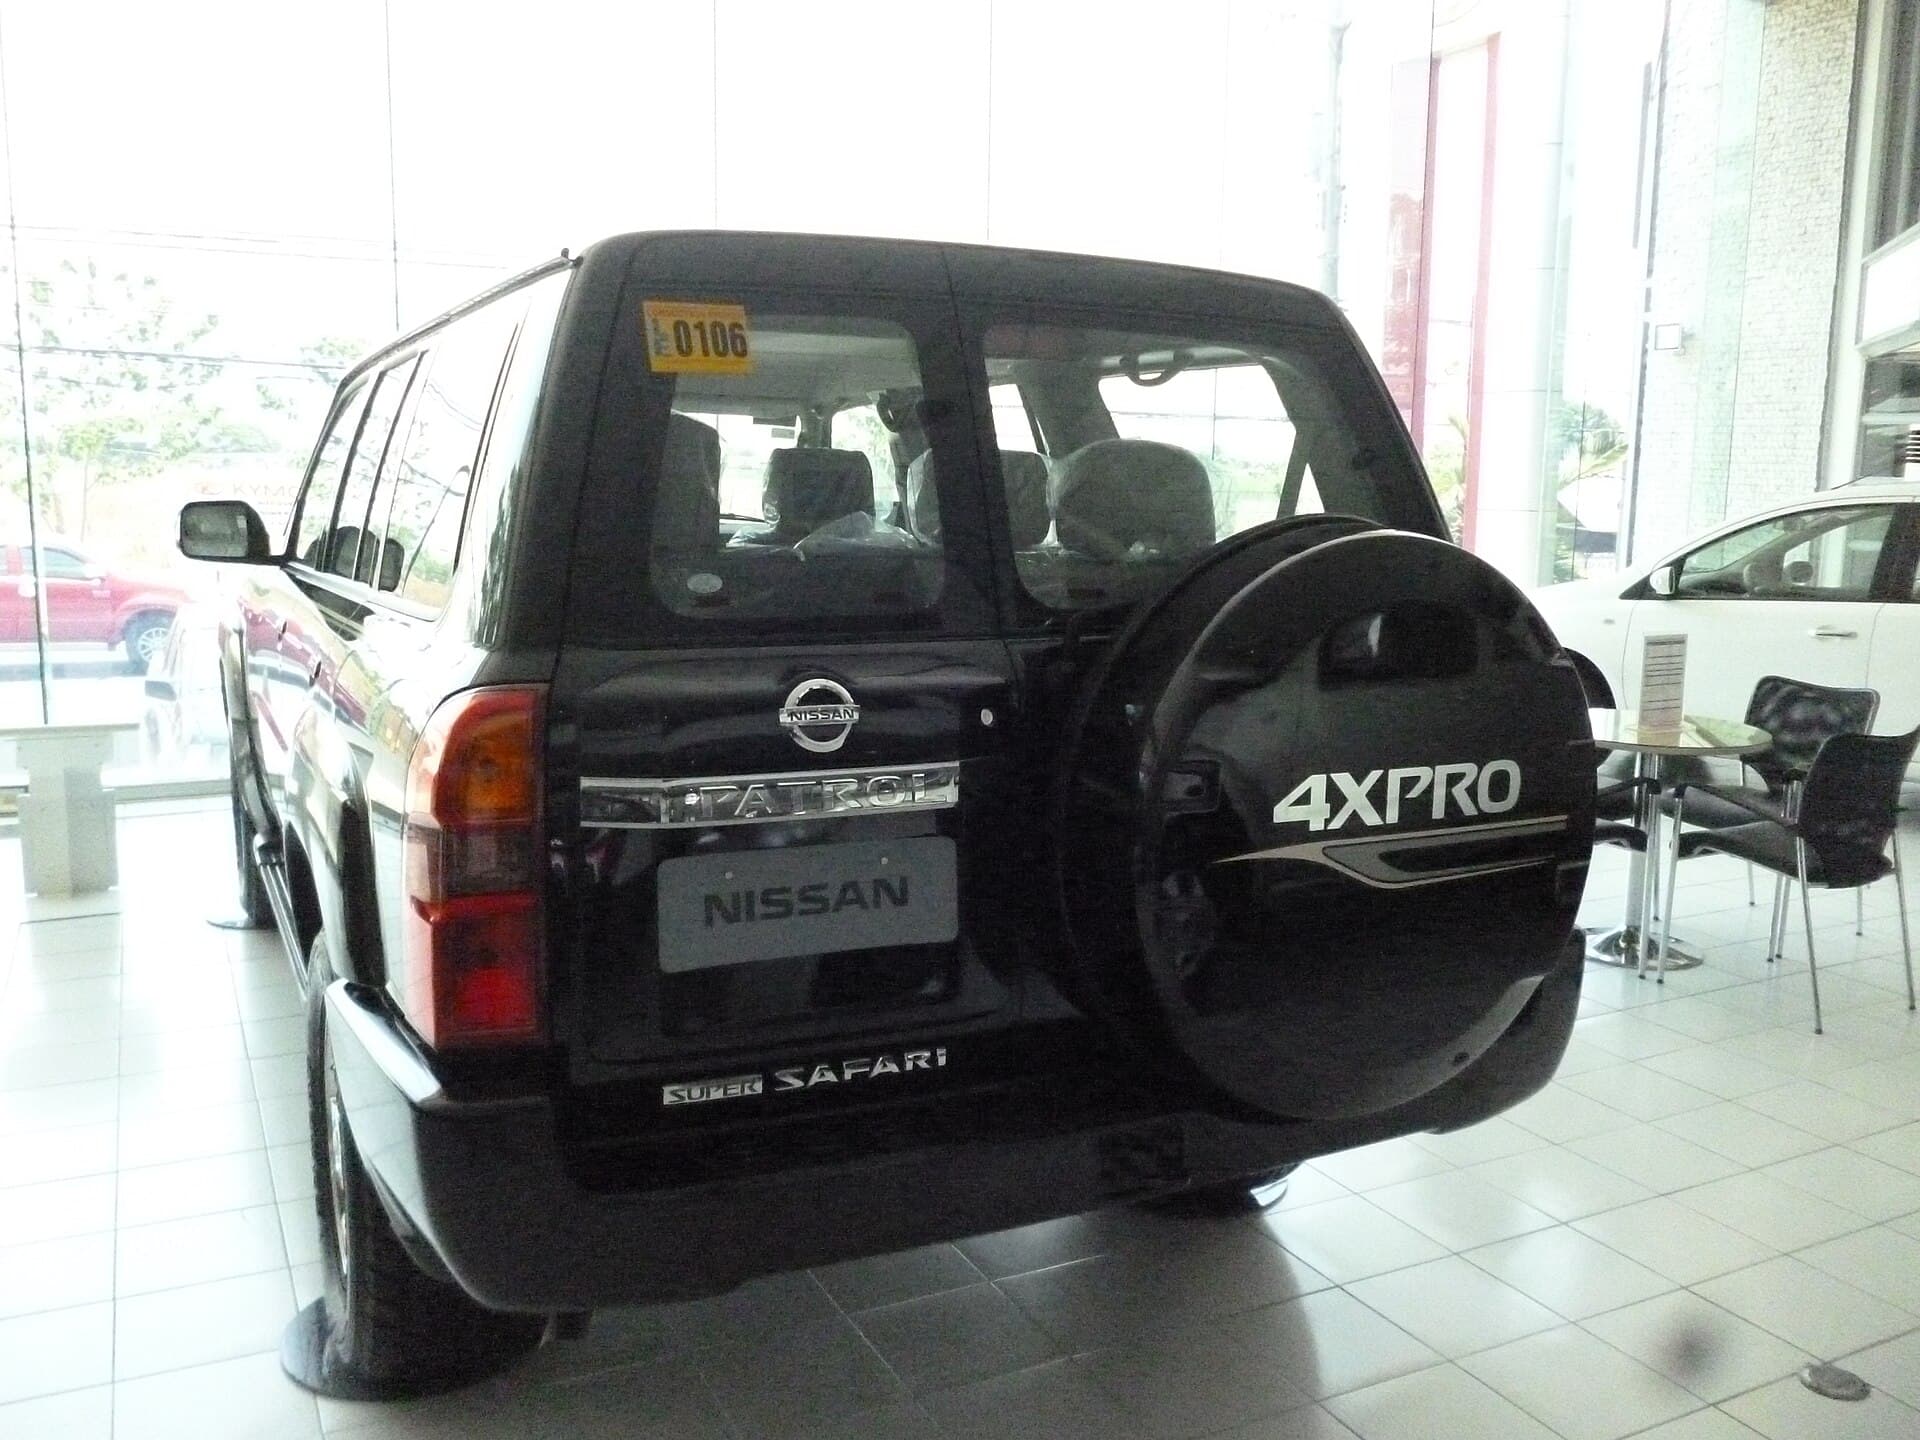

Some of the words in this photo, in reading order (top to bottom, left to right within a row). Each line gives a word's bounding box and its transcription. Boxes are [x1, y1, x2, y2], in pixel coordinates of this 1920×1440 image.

[673, 319, 748, 358] 0106
[232, 483, 298, 497] KYMC
[788, 708, 855, 722] NISSAN
[699, 772, 947, 819] PATROL
[1272, 759, 1522, 832] 4XPRO
[704, 876, 909, 928] NISSAN
[665, 1078, 761, 1104] SUPER
[775, 1048, 947, 1092] SAFARI
